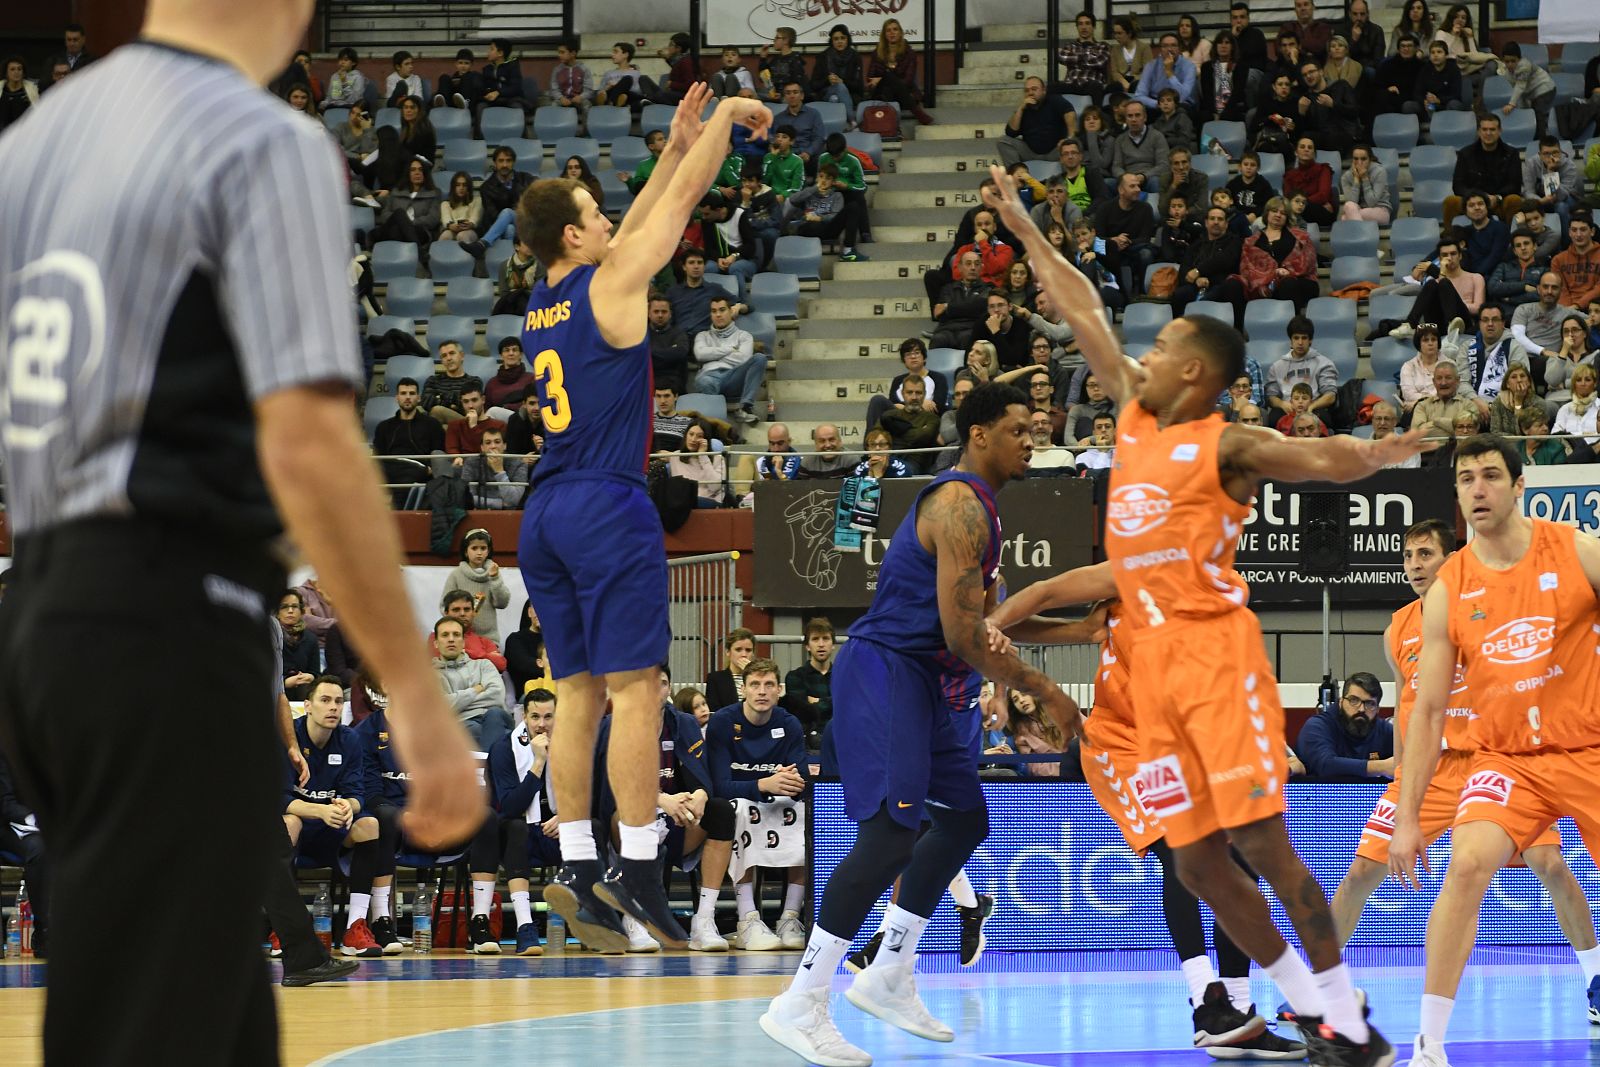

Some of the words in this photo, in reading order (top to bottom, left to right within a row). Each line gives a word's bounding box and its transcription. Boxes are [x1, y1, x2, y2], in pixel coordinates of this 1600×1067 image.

[415, 19, 427, 29] 12
[954, 193, 978, 203] FILA
[894, 302, 920, 312] FILA
[533, 349, 572, 433] 3
[858, 383, 884, 394] FILA
[1236, 533, 1259, 552] WE
[1267, 533, 1300, 552] CRE
[1349, 533, 1401, 553] HANG
[1236, 570, 1275, 584] ARCA
[1278, 571, 1287, 583] Y
[303, 788, 336, 799] LASS
